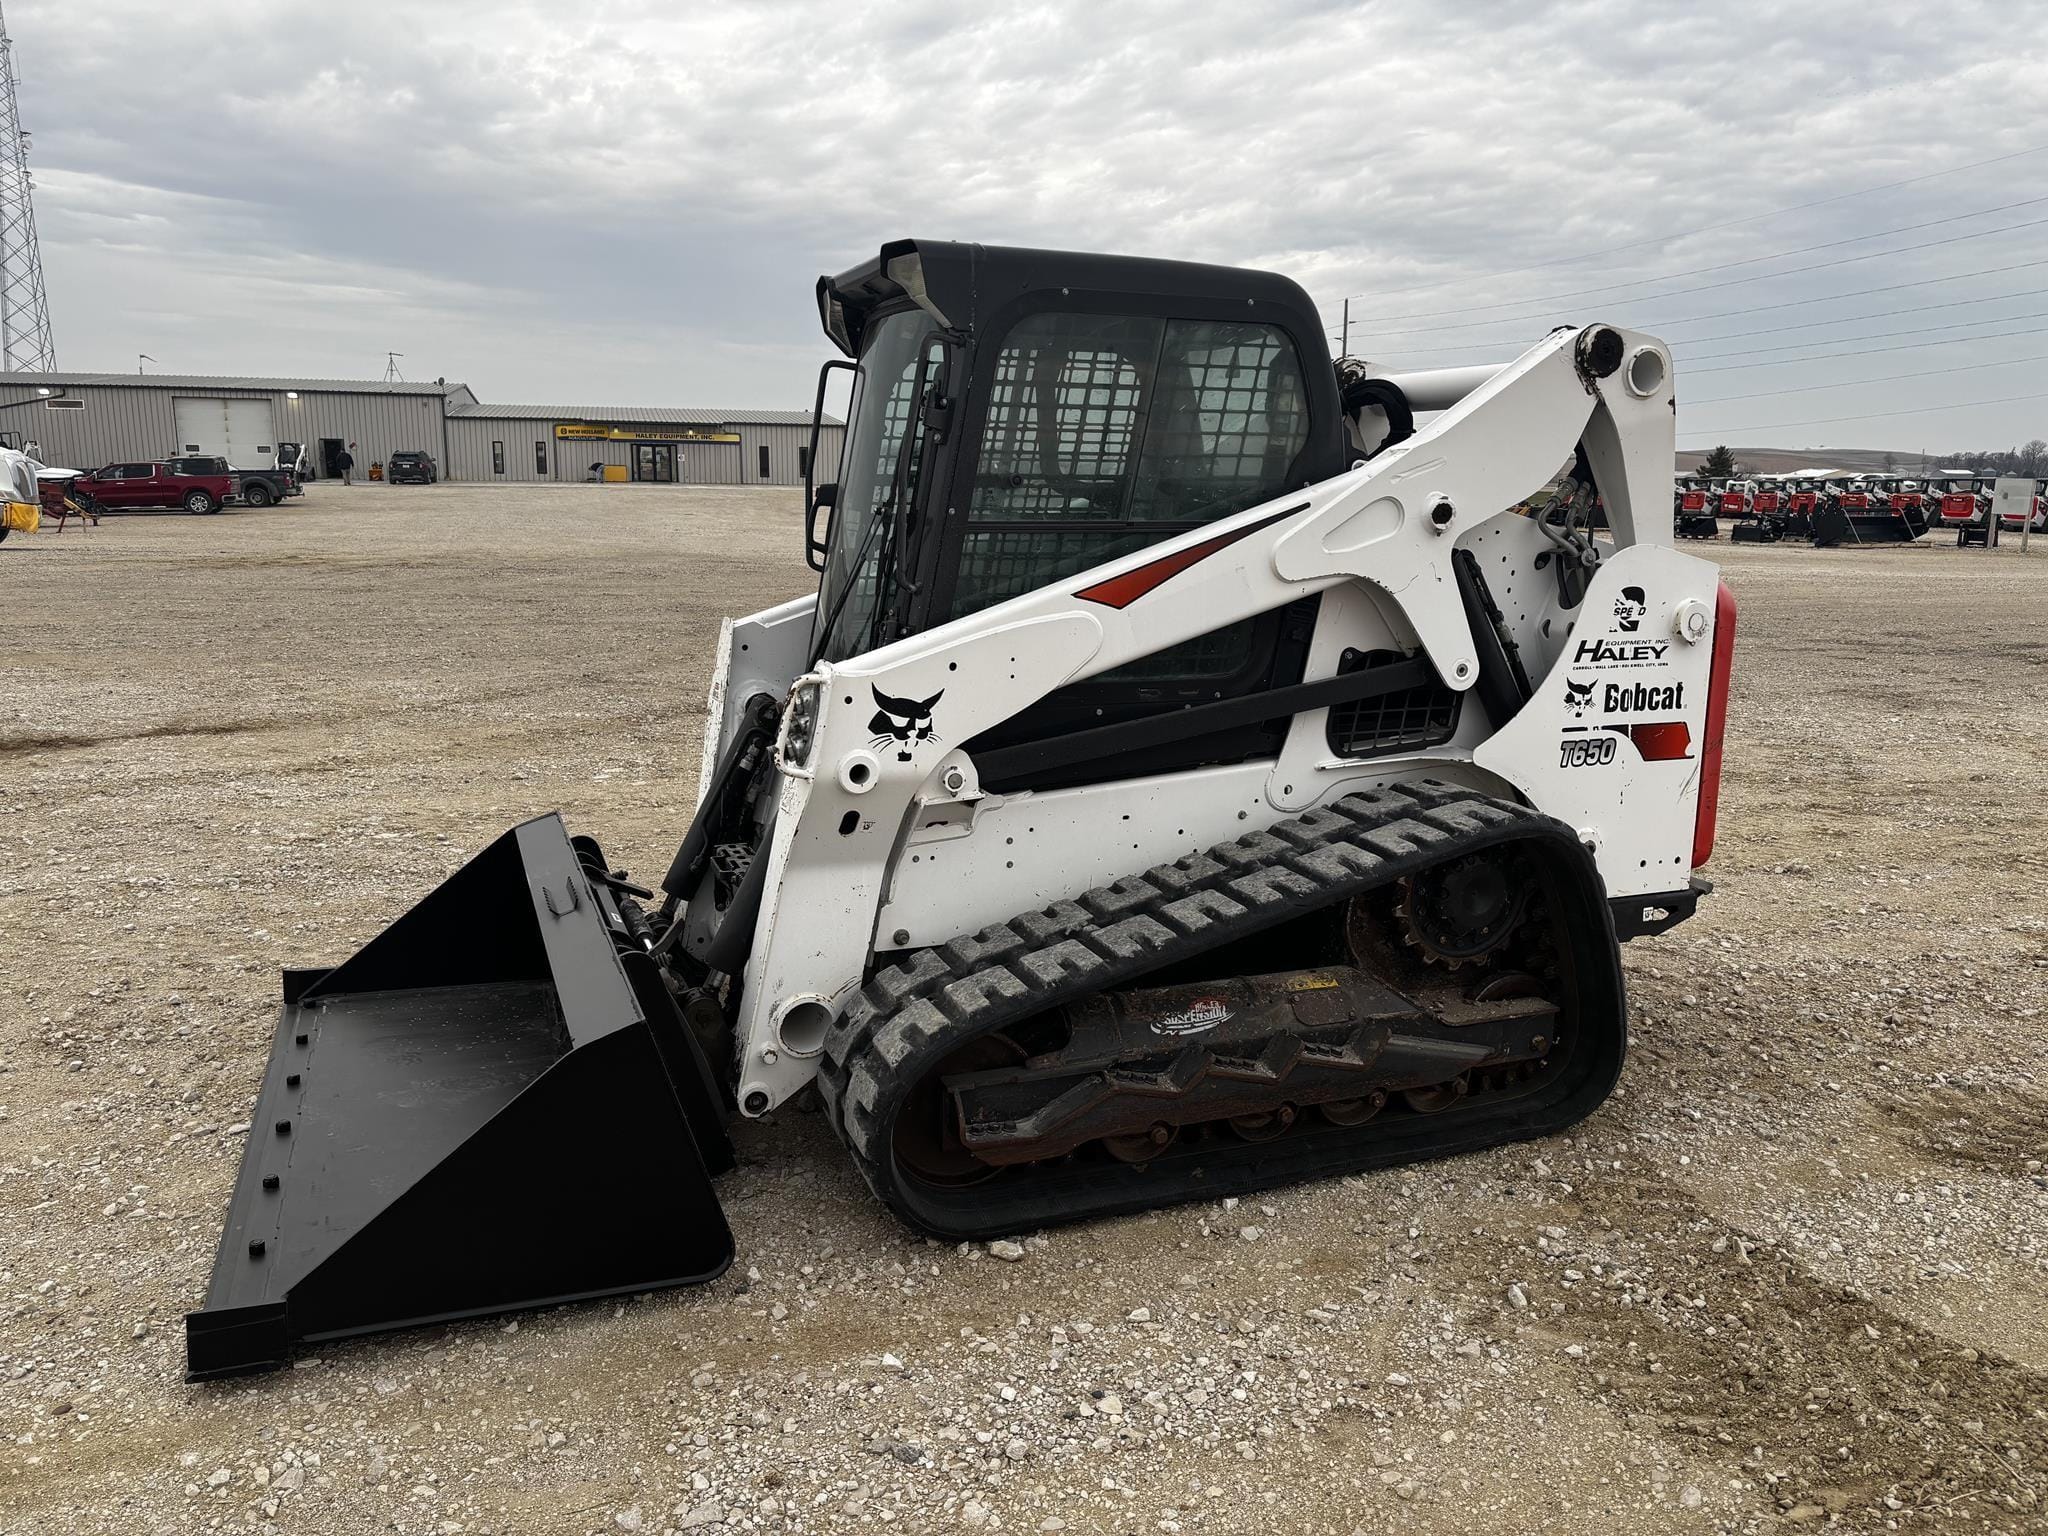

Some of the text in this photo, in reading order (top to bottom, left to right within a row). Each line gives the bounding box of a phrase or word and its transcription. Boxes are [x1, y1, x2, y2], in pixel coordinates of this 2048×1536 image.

[1573, 639, 1670, 663] HALEY
[1604, 682, 1684, 713] Bobcat
[1560, 738, 1617, 768] T650
